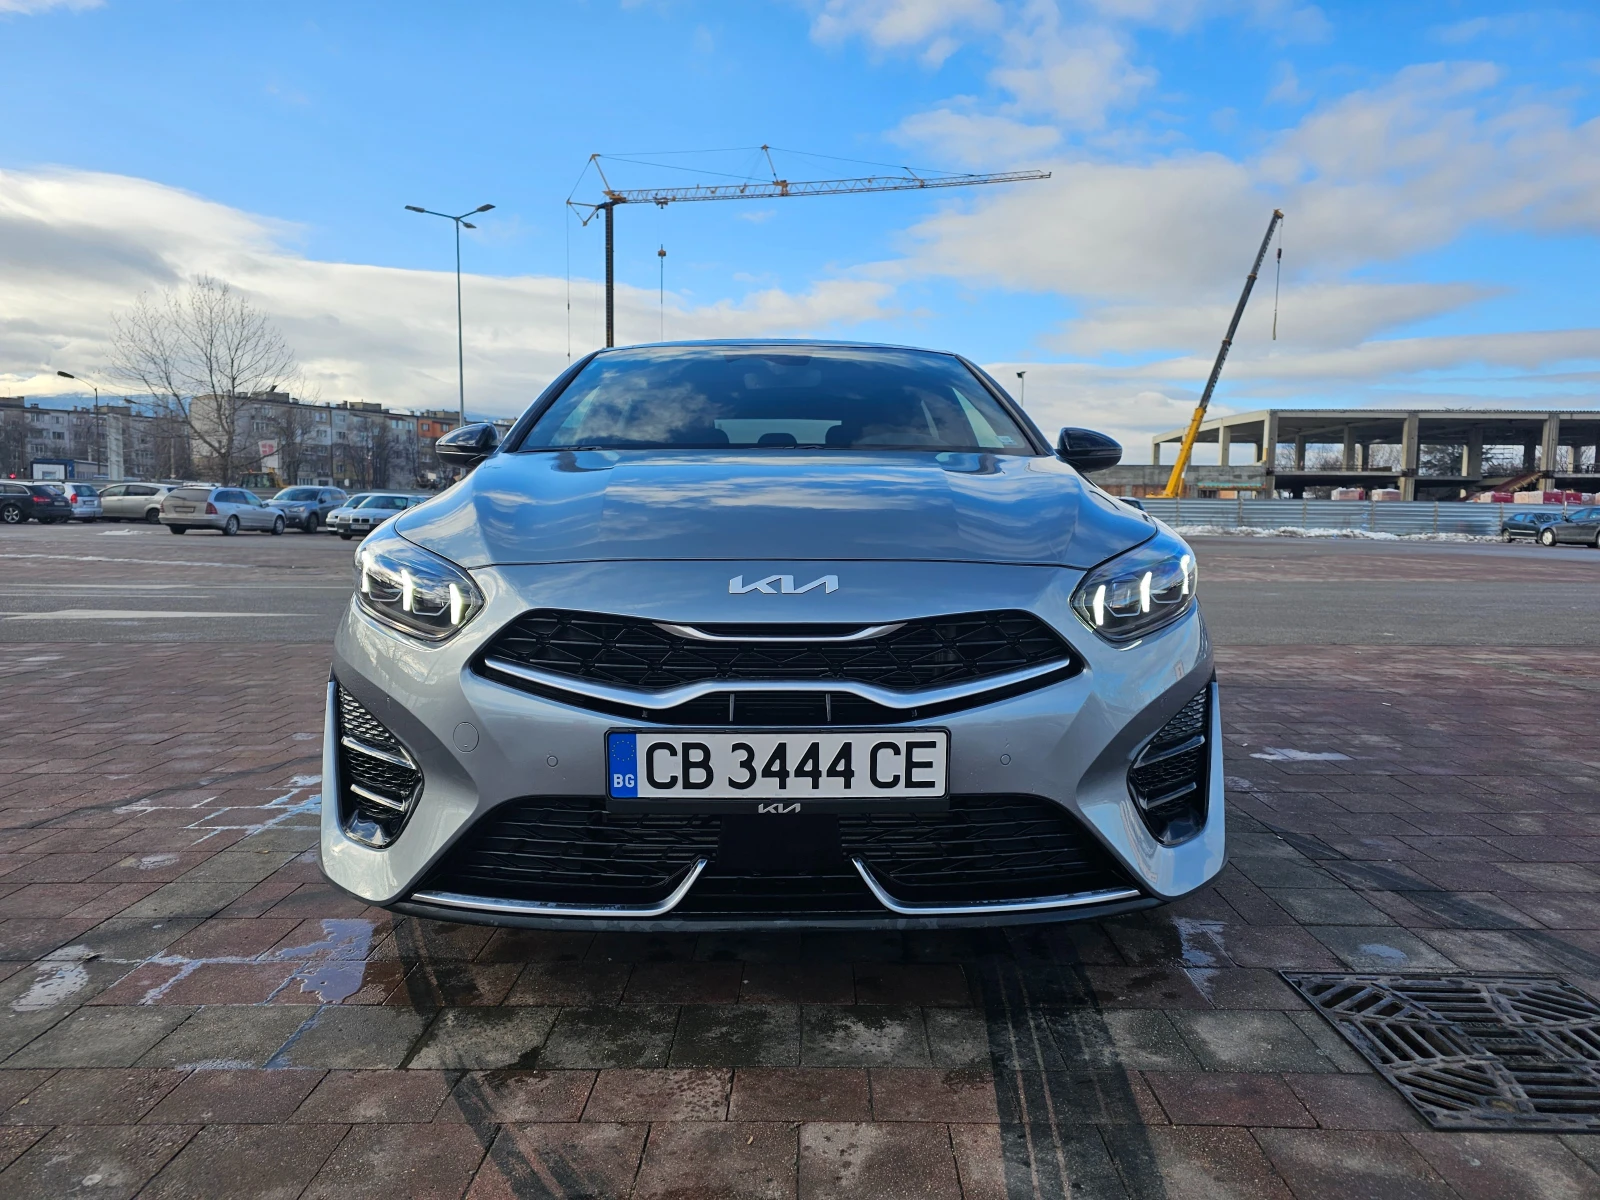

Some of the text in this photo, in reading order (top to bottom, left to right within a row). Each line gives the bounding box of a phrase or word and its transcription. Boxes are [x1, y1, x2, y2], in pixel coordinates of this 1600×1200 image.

[729, 574, 839, 594] KIA
[645, 741, 937, 790] CB 3444 CE
[613, 773, 635, 788] BG
[758, 803, 801, 814] KIA
